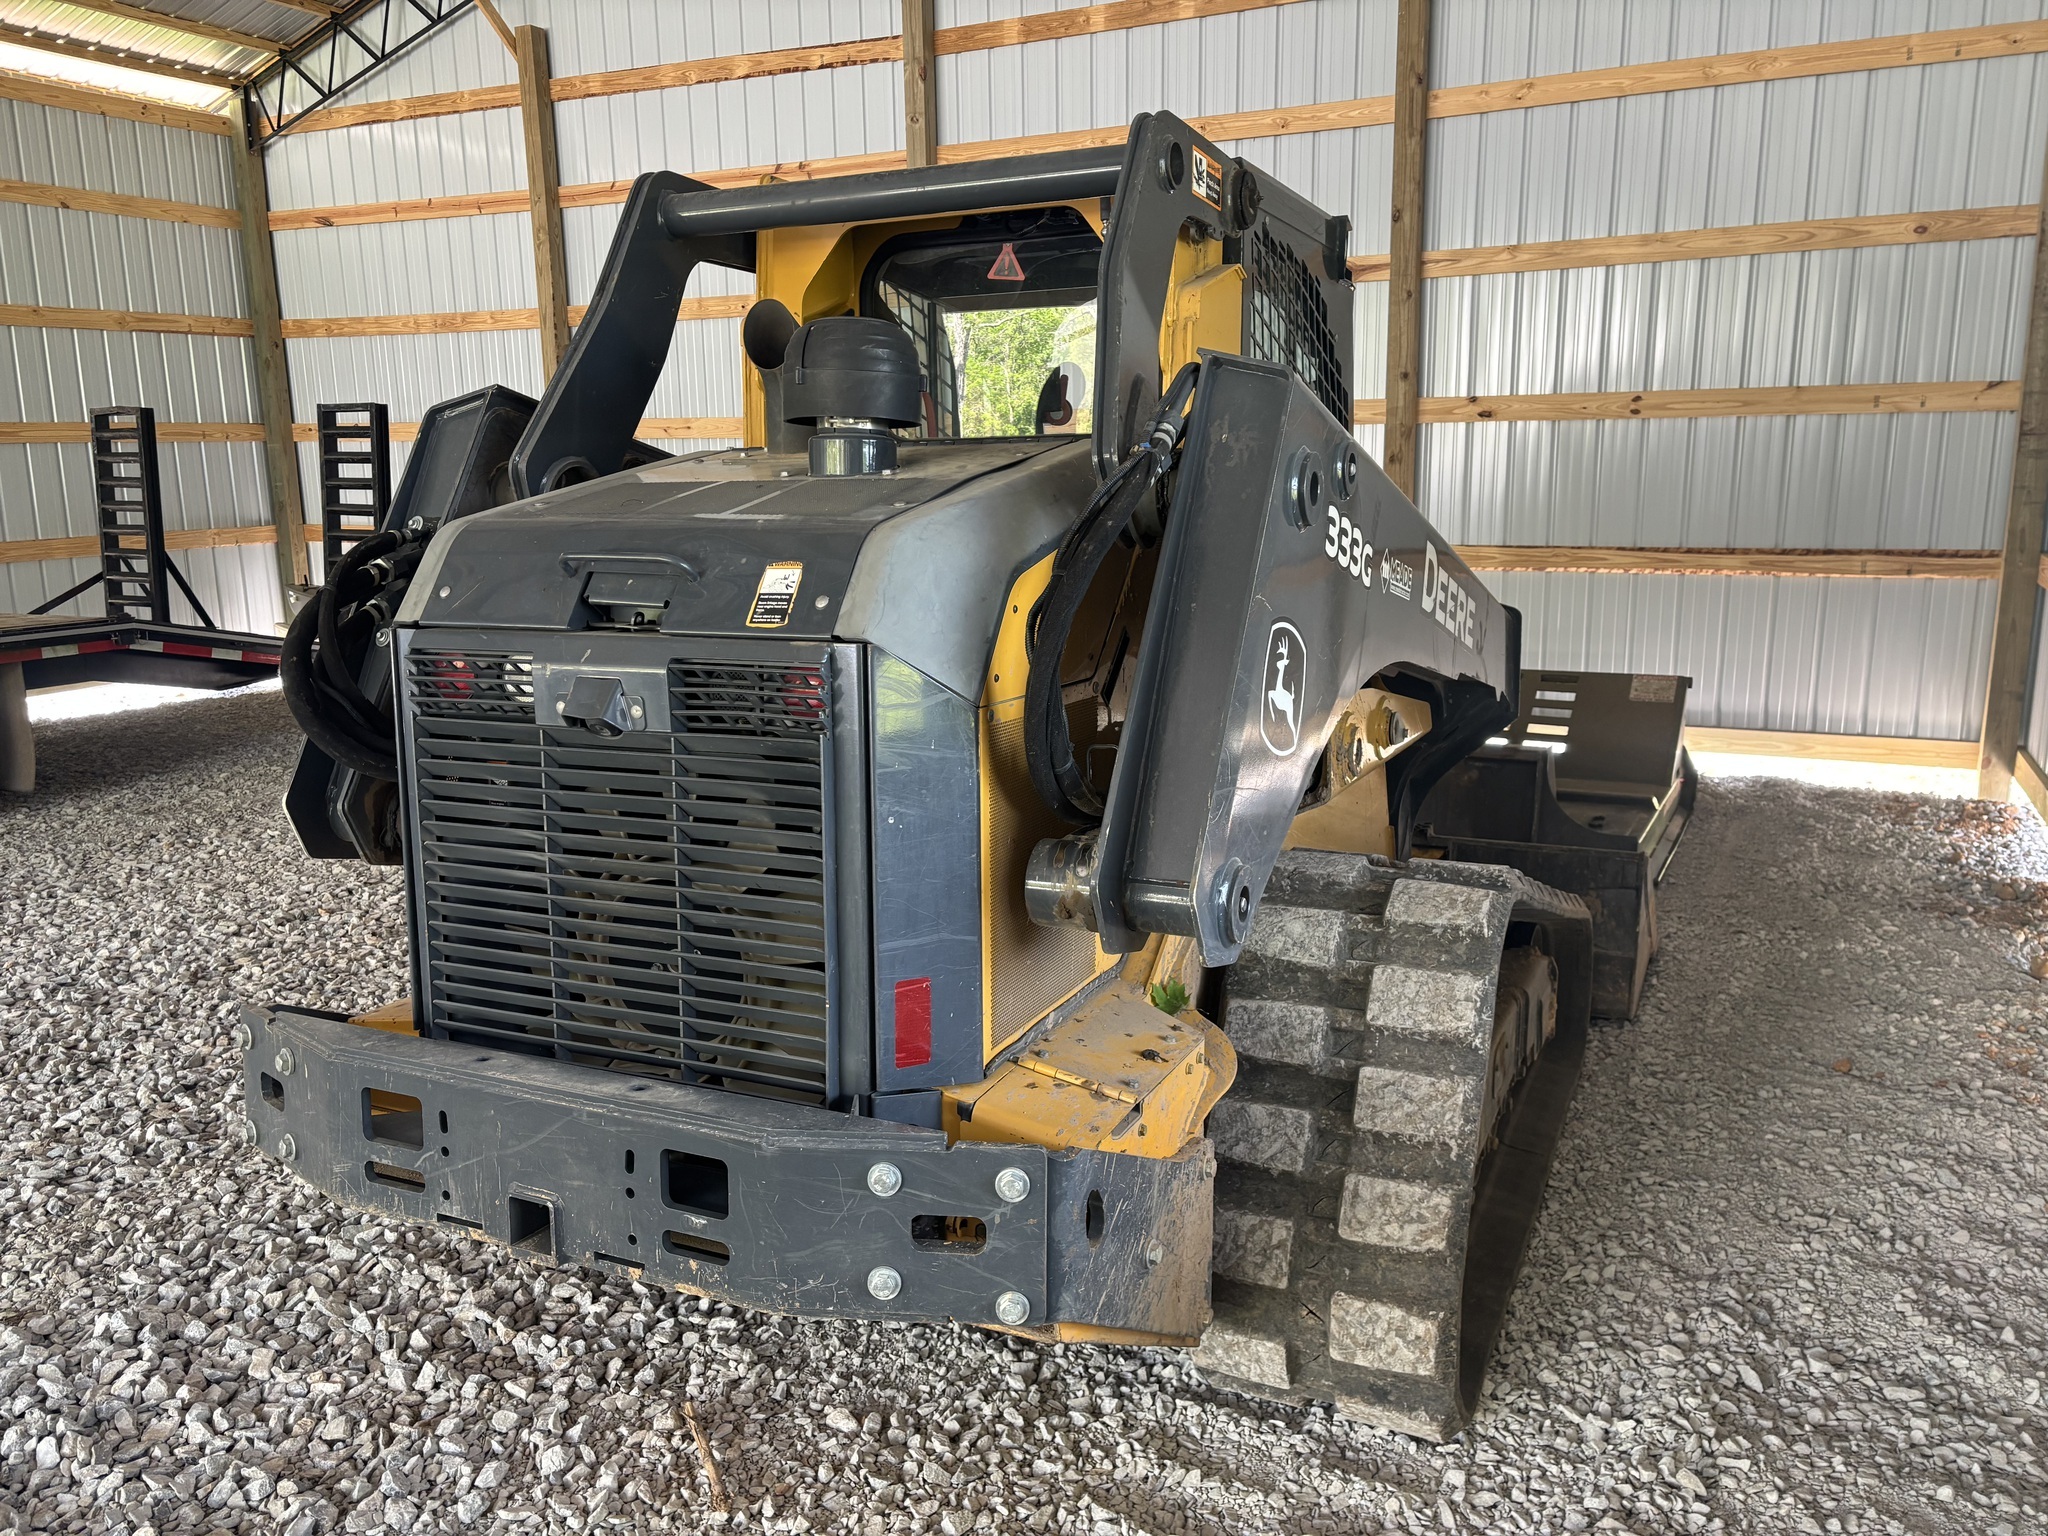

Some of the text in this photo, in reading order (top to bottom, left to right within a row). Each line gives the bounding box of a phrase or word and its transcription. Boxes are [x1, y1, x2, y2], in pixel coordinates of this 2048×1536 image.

[1325, 505, 1373, 587] 333G
[1390, 557, 1413, 589] MEADE
[1421, 539, 1476, 650] DEERE
